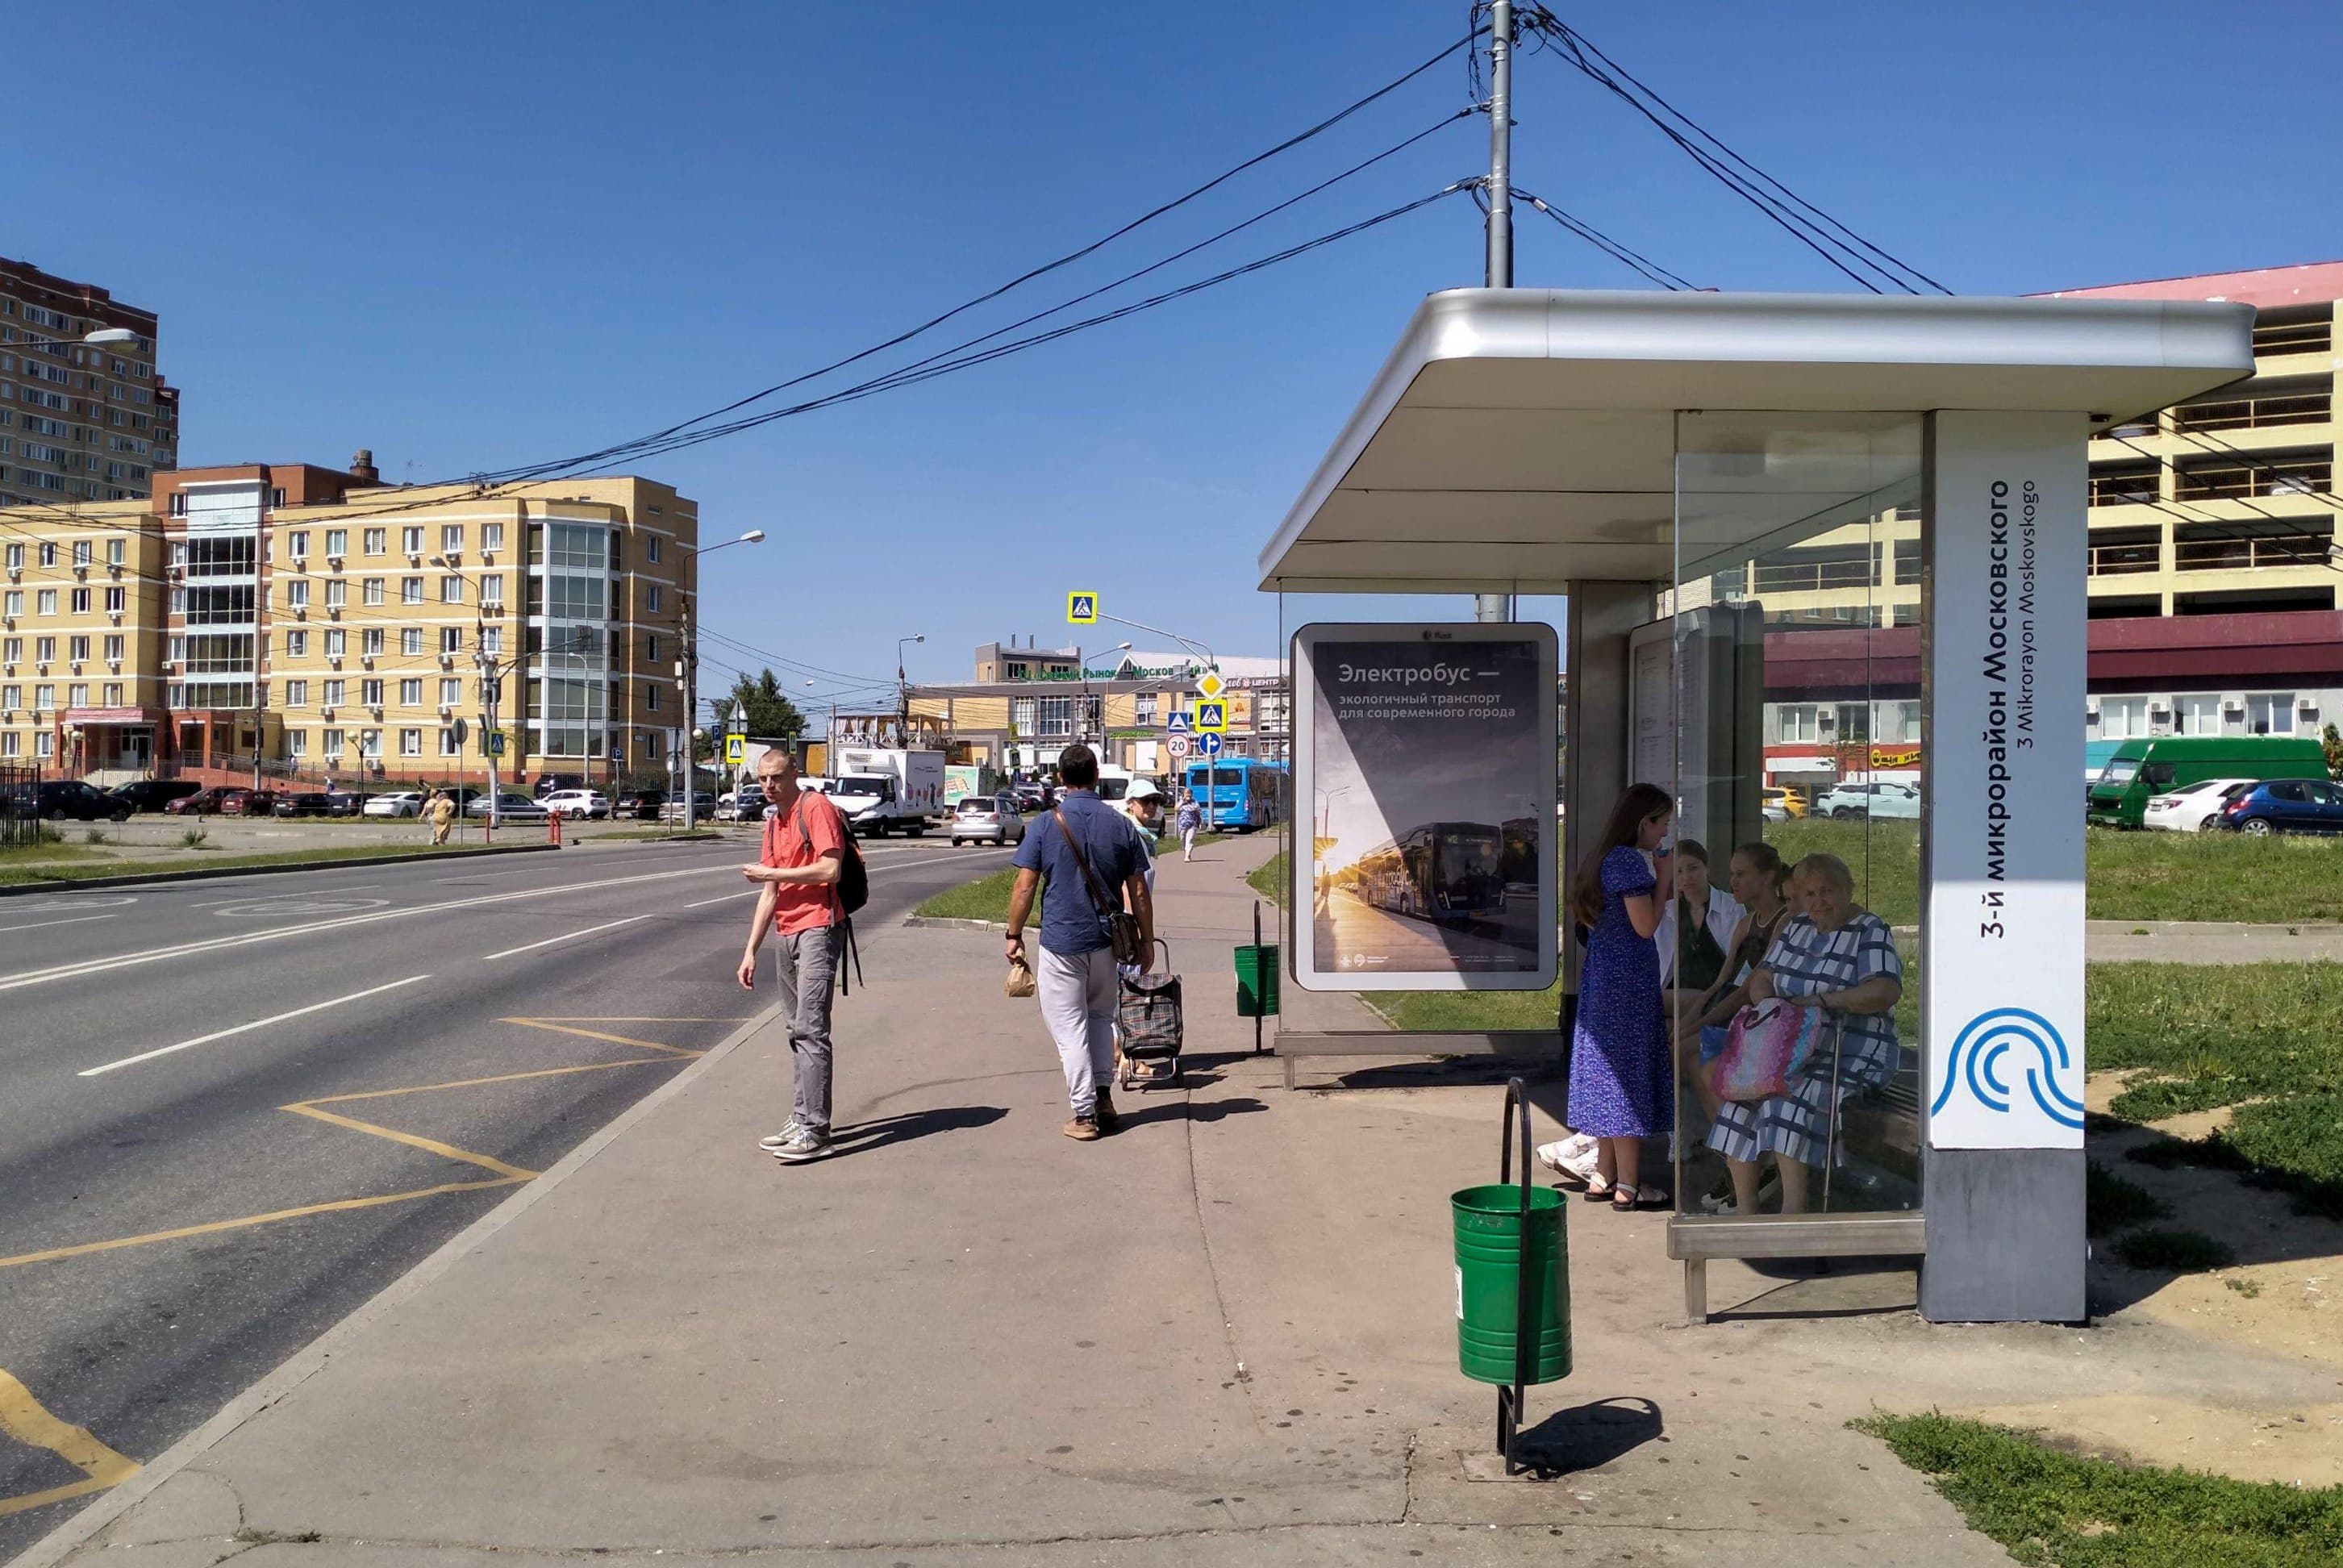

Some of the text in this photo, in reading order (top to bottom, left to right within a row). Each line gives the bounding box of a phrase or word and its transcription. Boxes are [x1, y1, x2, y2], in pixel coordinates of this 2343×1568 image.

[2017, 480, 2039, 749] 3 Mikrorayon Moskovskogo
[1338, 662, 1470, 686] Электробус
[1252, 678, 1279, 687] ЦЕНТР
[1339, 693, 1501, 709] экологичный транспорт
[1981, 480, 2011, 938] 3-й микрорайон Московского
[1339, 708, 1515, 721] для современного города
[1171, 741, 1185, 751] 20
